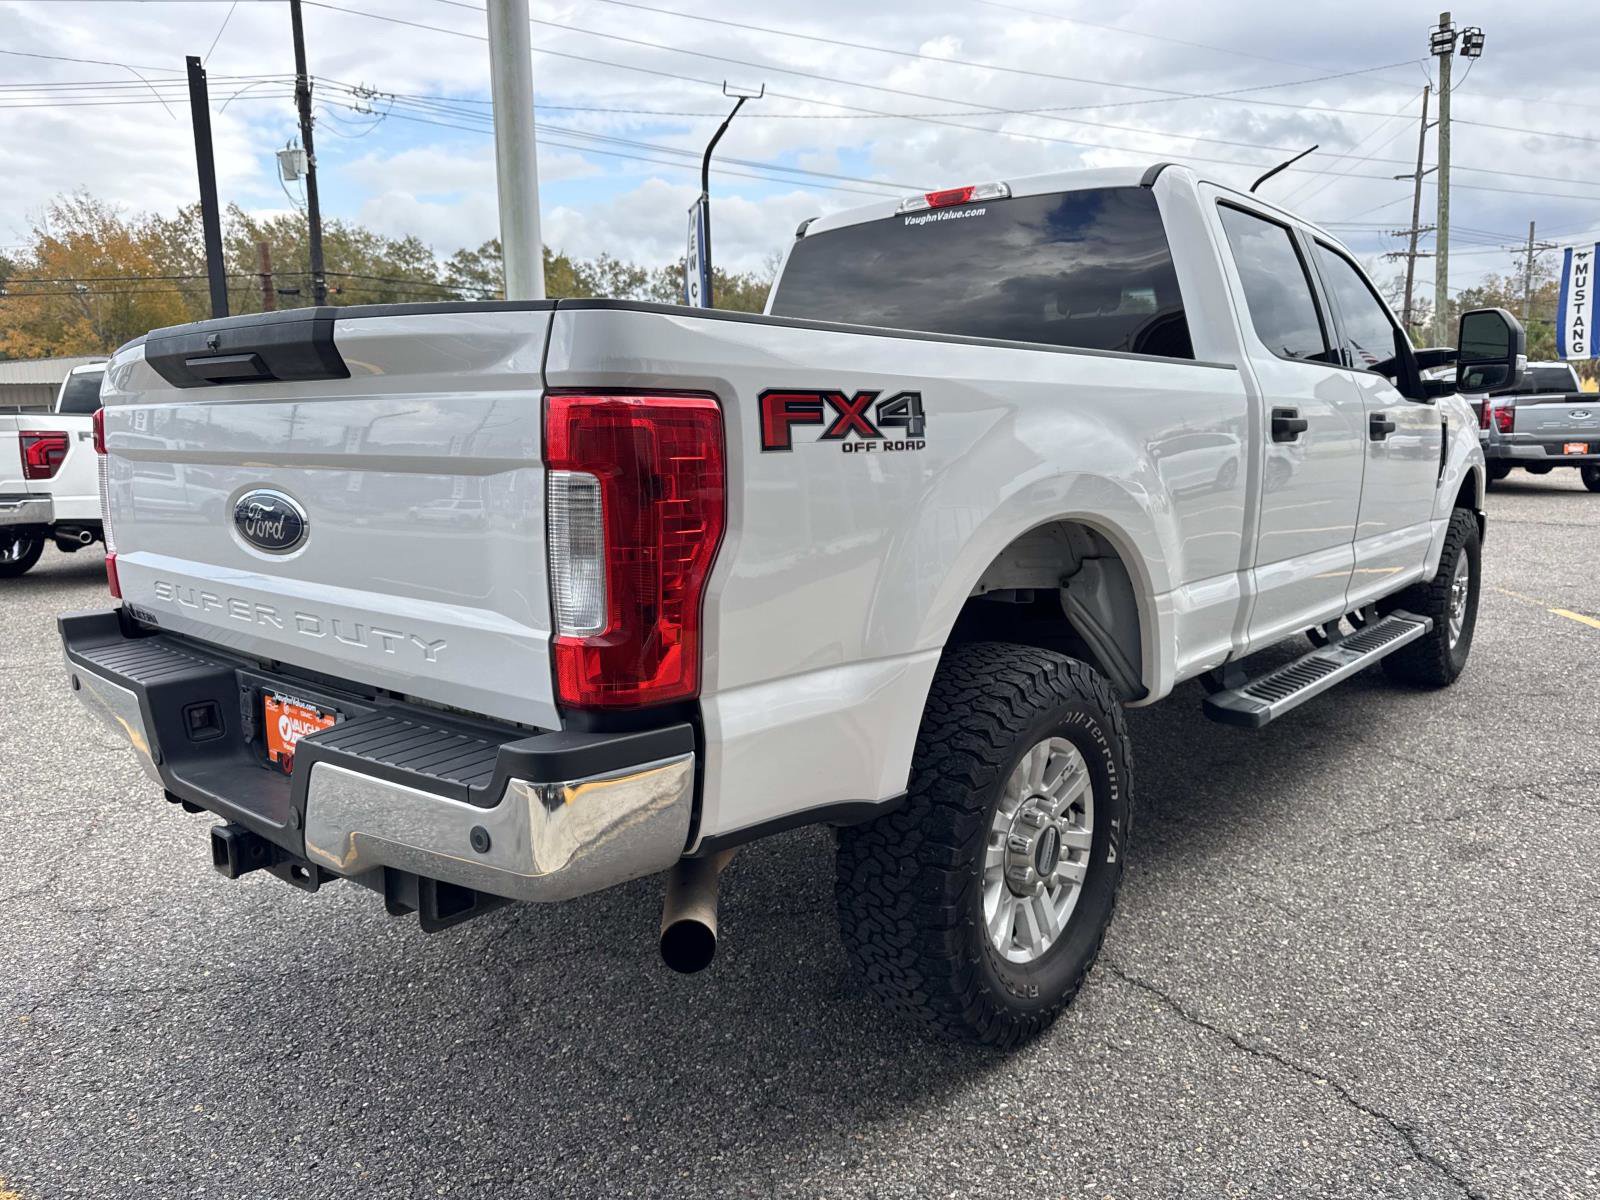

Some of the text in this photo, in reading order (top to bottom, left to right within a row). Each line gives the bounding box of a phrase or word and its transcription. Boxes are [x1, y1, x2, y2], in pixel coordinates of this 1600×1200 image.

[904, 208, 986, 226] VaughnValue.com
[1573, 263, 1588, 353] MUSTANG
[757, 387, 926, 453] FX4
[842, 440, 926, 453] OFF ROAD
[246, 502, 286, 540] Ford
[154, 580, 284, 629] SUPER
[295, 611, 447, 663] DUTY
